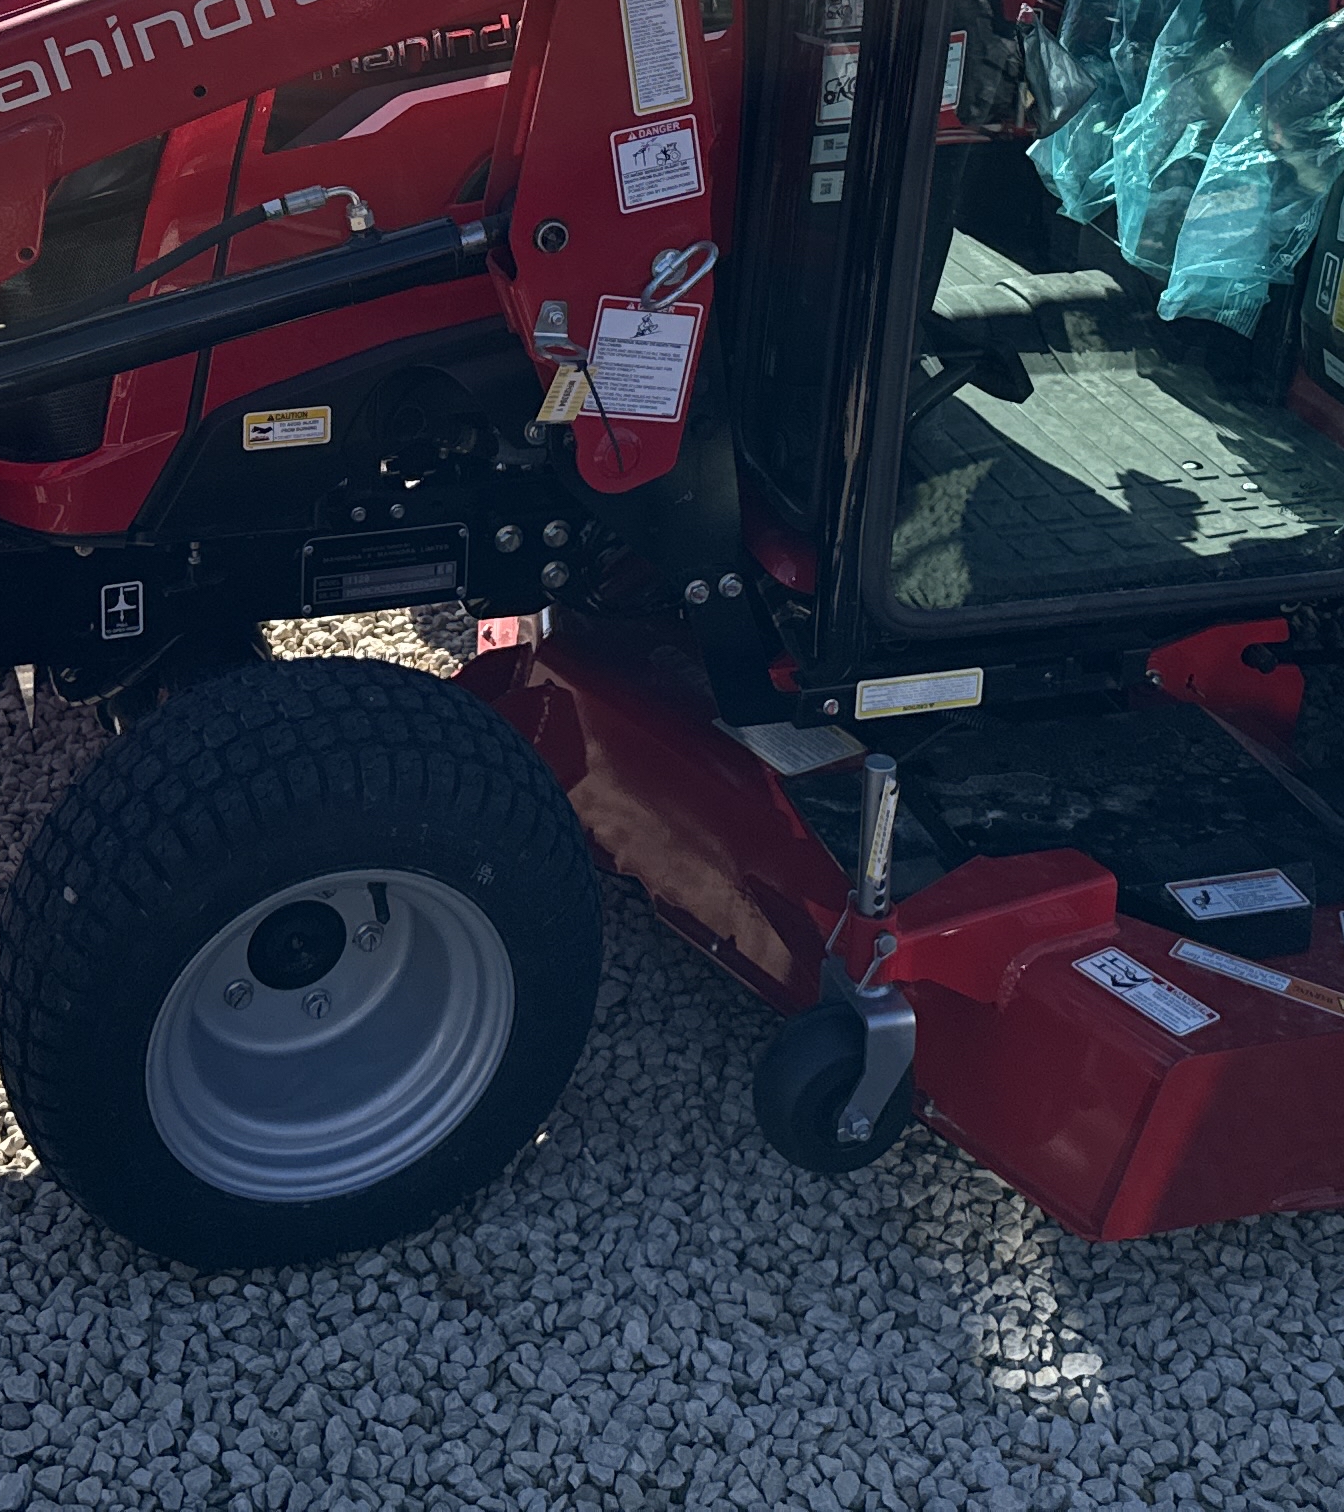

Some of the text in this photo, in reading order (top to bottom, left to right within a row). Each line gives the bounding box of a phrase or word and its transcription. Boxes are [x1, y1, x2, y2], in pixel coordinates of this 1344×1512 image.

[311, 13, 522, 81] ahind
[638, 121, 680, 138] DANGER
[276, 411, 308, 420] CAUTION
